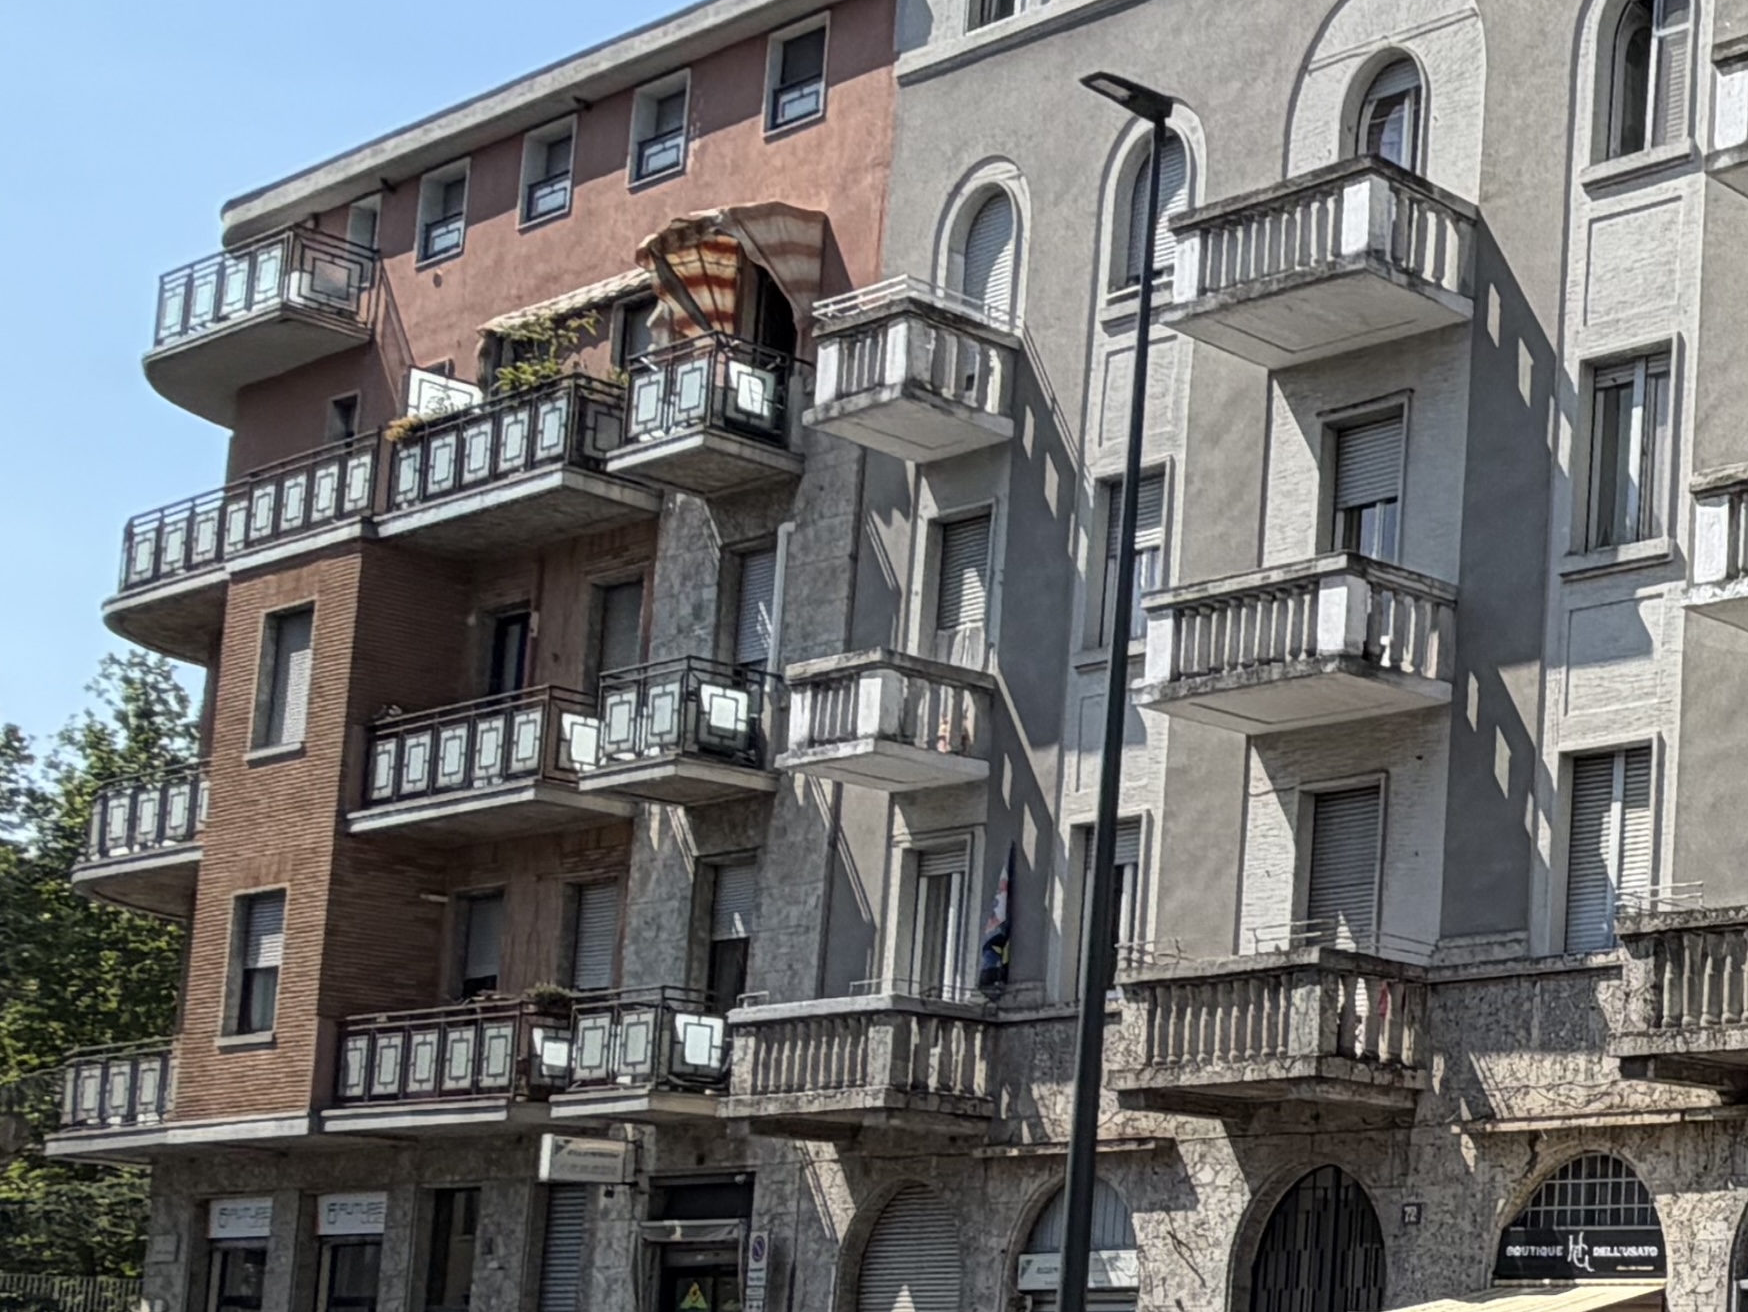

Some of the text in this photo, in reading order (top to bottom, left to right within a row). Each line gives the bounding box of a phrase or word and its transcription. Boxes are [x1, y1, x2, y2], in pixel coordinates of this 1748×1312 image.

[1403, 1205, 1418, 1223] 72
[1506, 1245, 1564, 1257] BOUTIQUE
[1592, 1245, 1659, 1258] DELL'USATO
